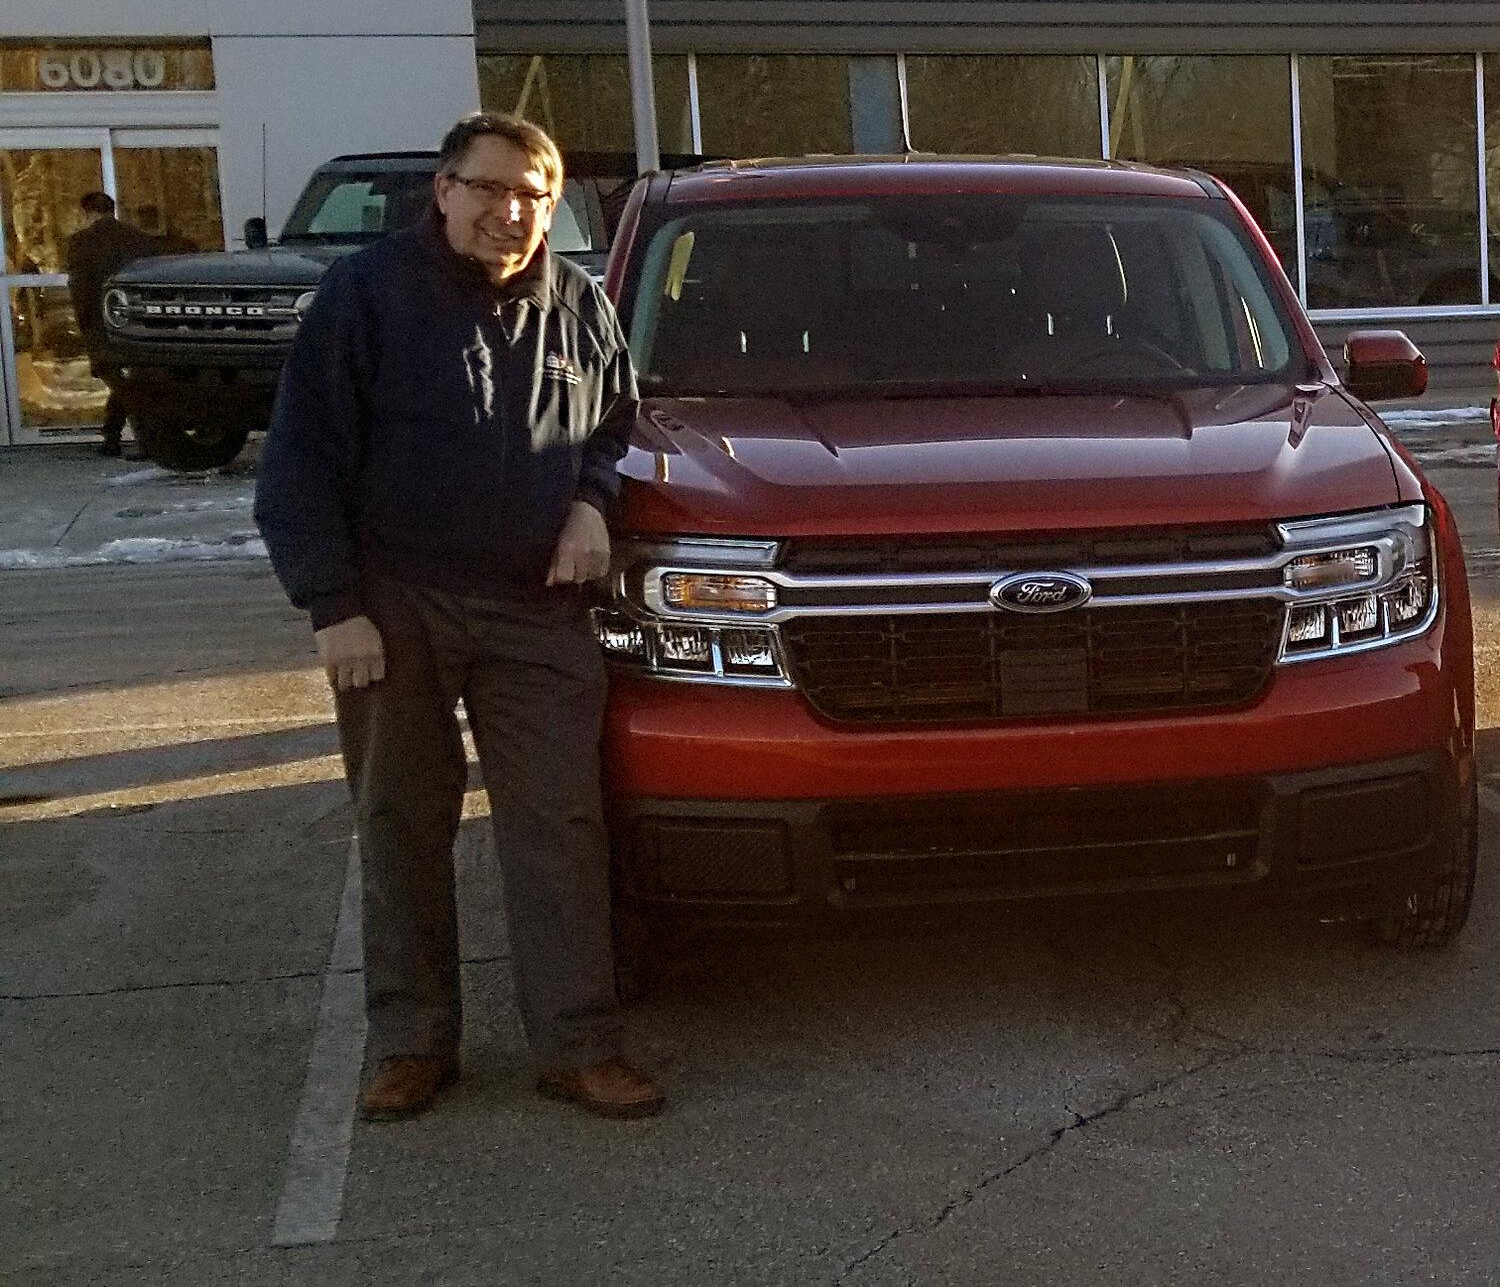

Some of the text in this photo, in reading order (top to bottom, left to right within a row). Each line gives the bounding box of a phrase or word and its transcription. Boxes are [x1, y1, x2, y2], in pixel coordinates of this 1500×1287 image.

[38, 48, 165, 88] 6080
[146, 306, 264, 315] BRONCO
[1016, 582, 1068, 604] Ford
